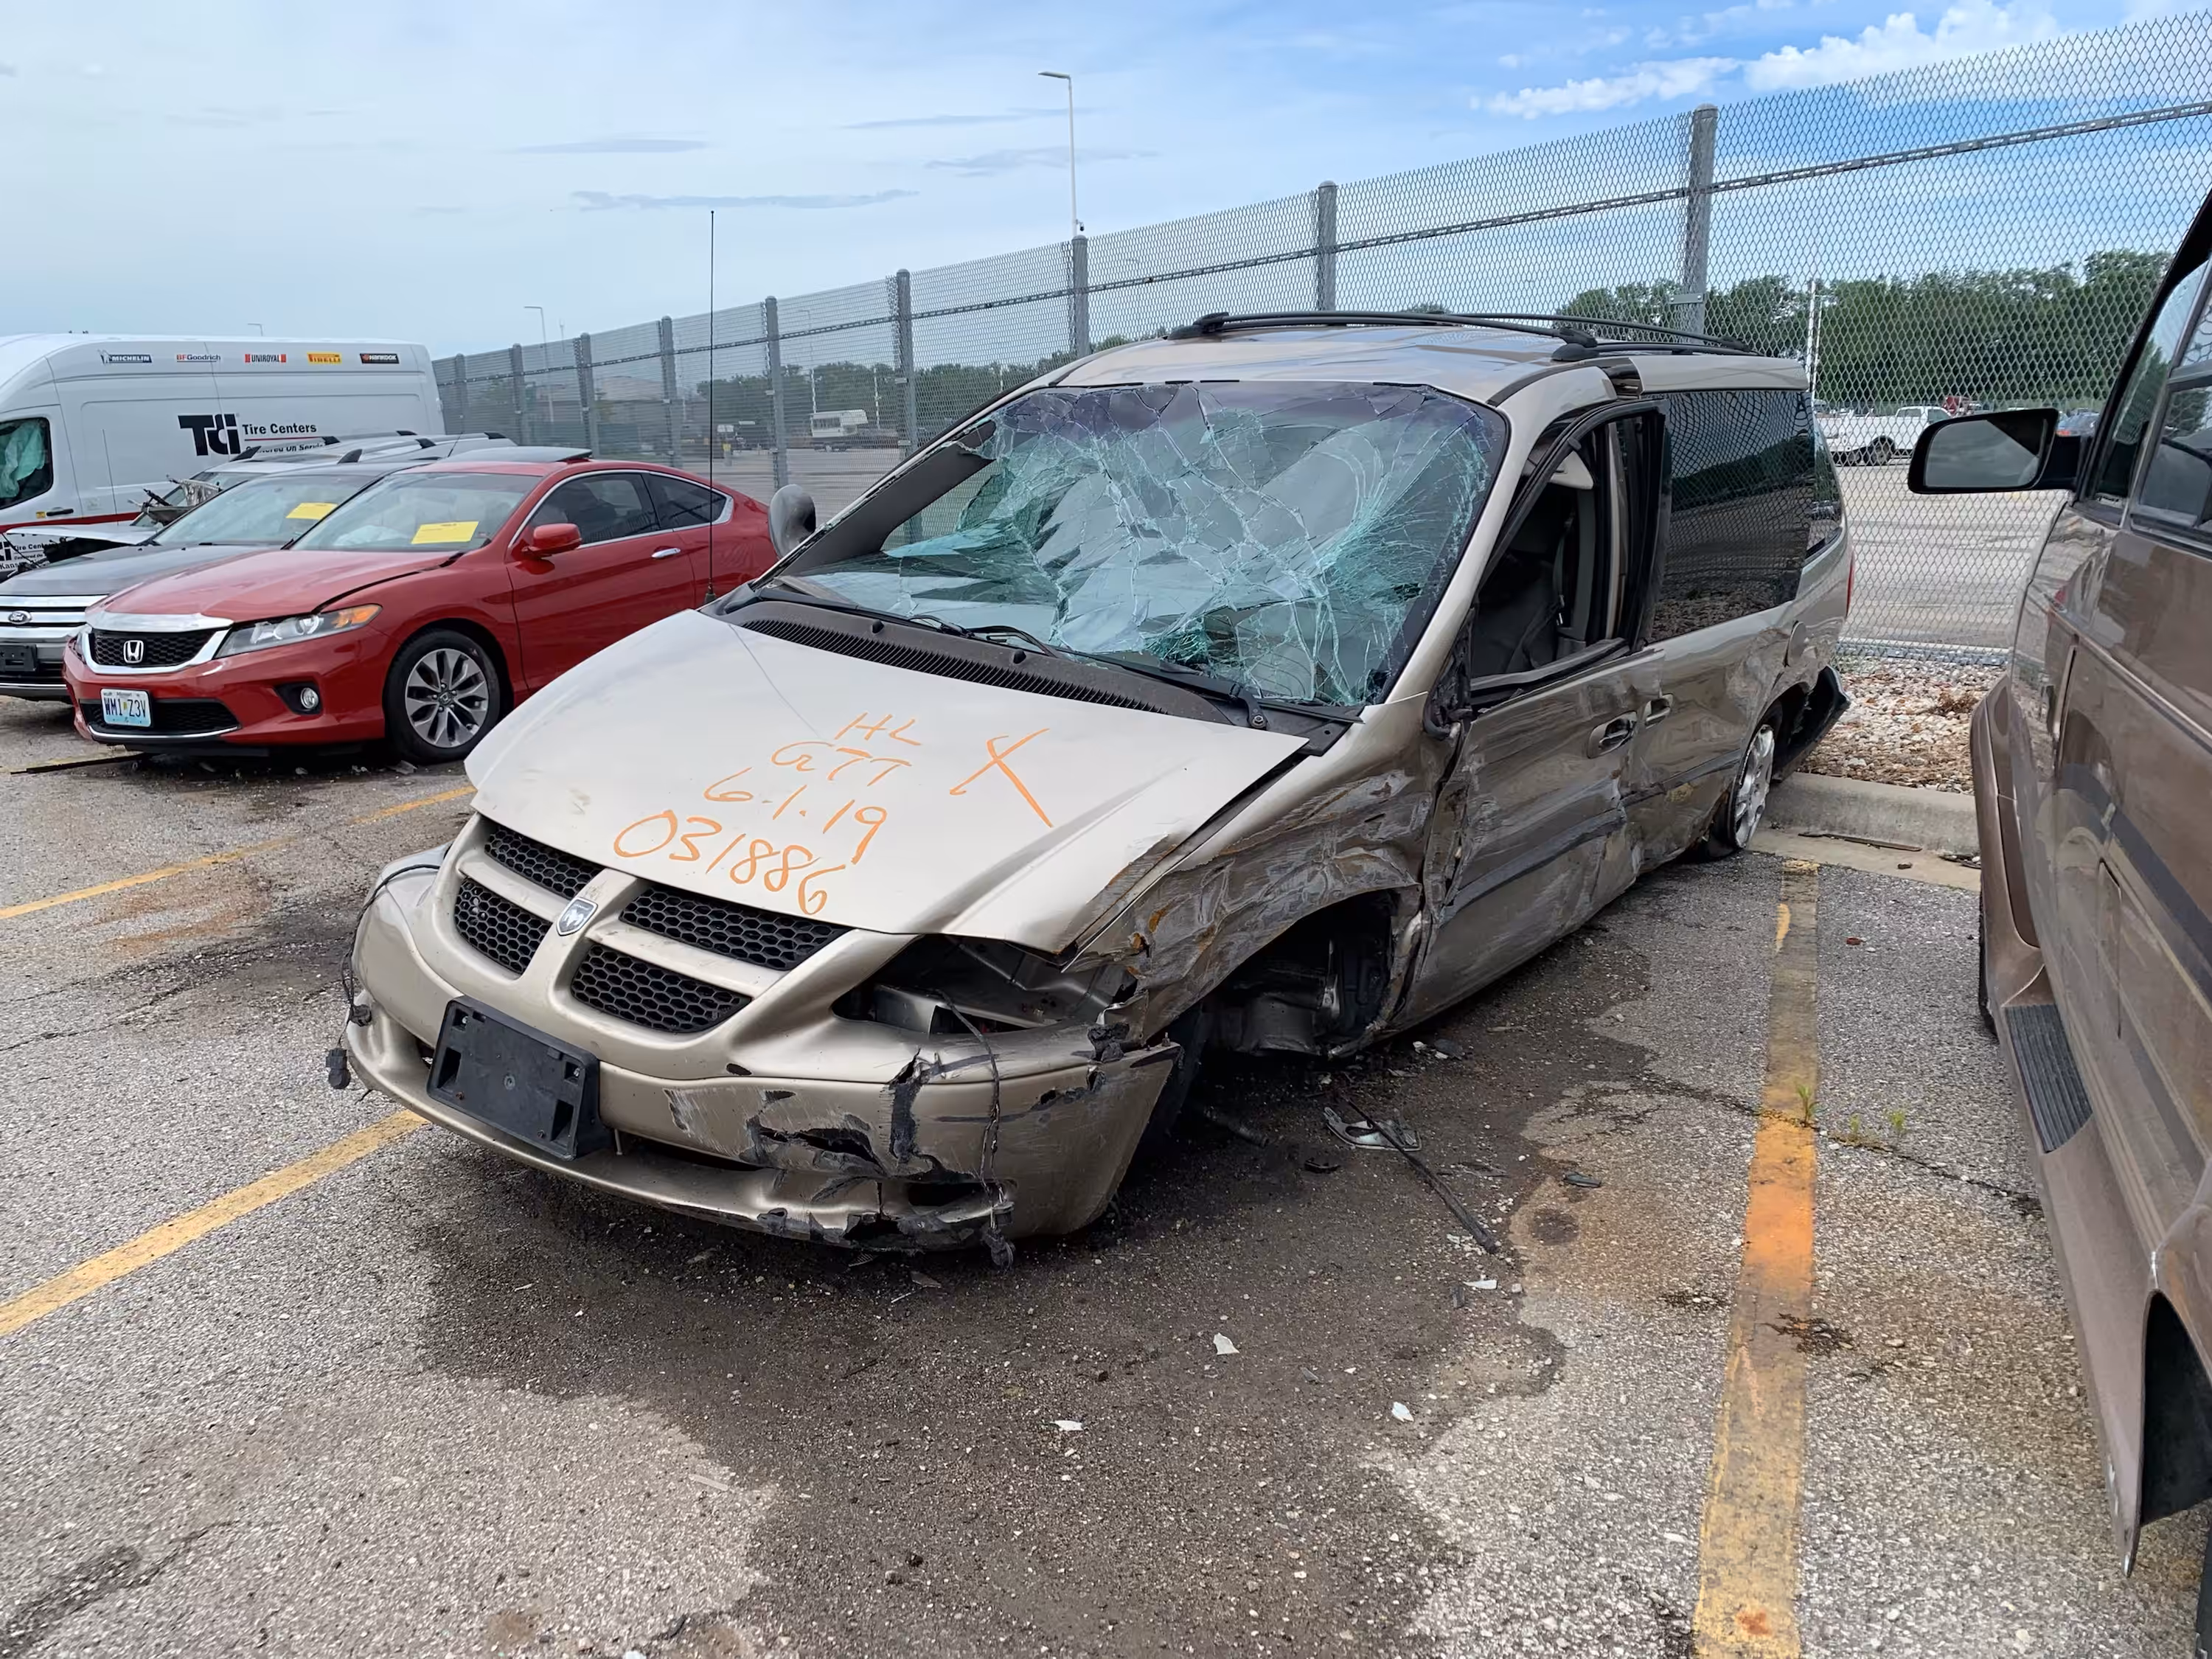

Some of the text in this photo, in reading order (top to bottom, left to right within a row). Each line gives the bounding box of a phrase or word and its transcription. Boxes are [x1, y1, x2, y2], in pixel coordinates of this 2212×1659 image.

[251, 354, 280, 363] UNIROYAL
[242, 422, 317, 435] Tire Centers
[613, 810, 846, 916] 031886
